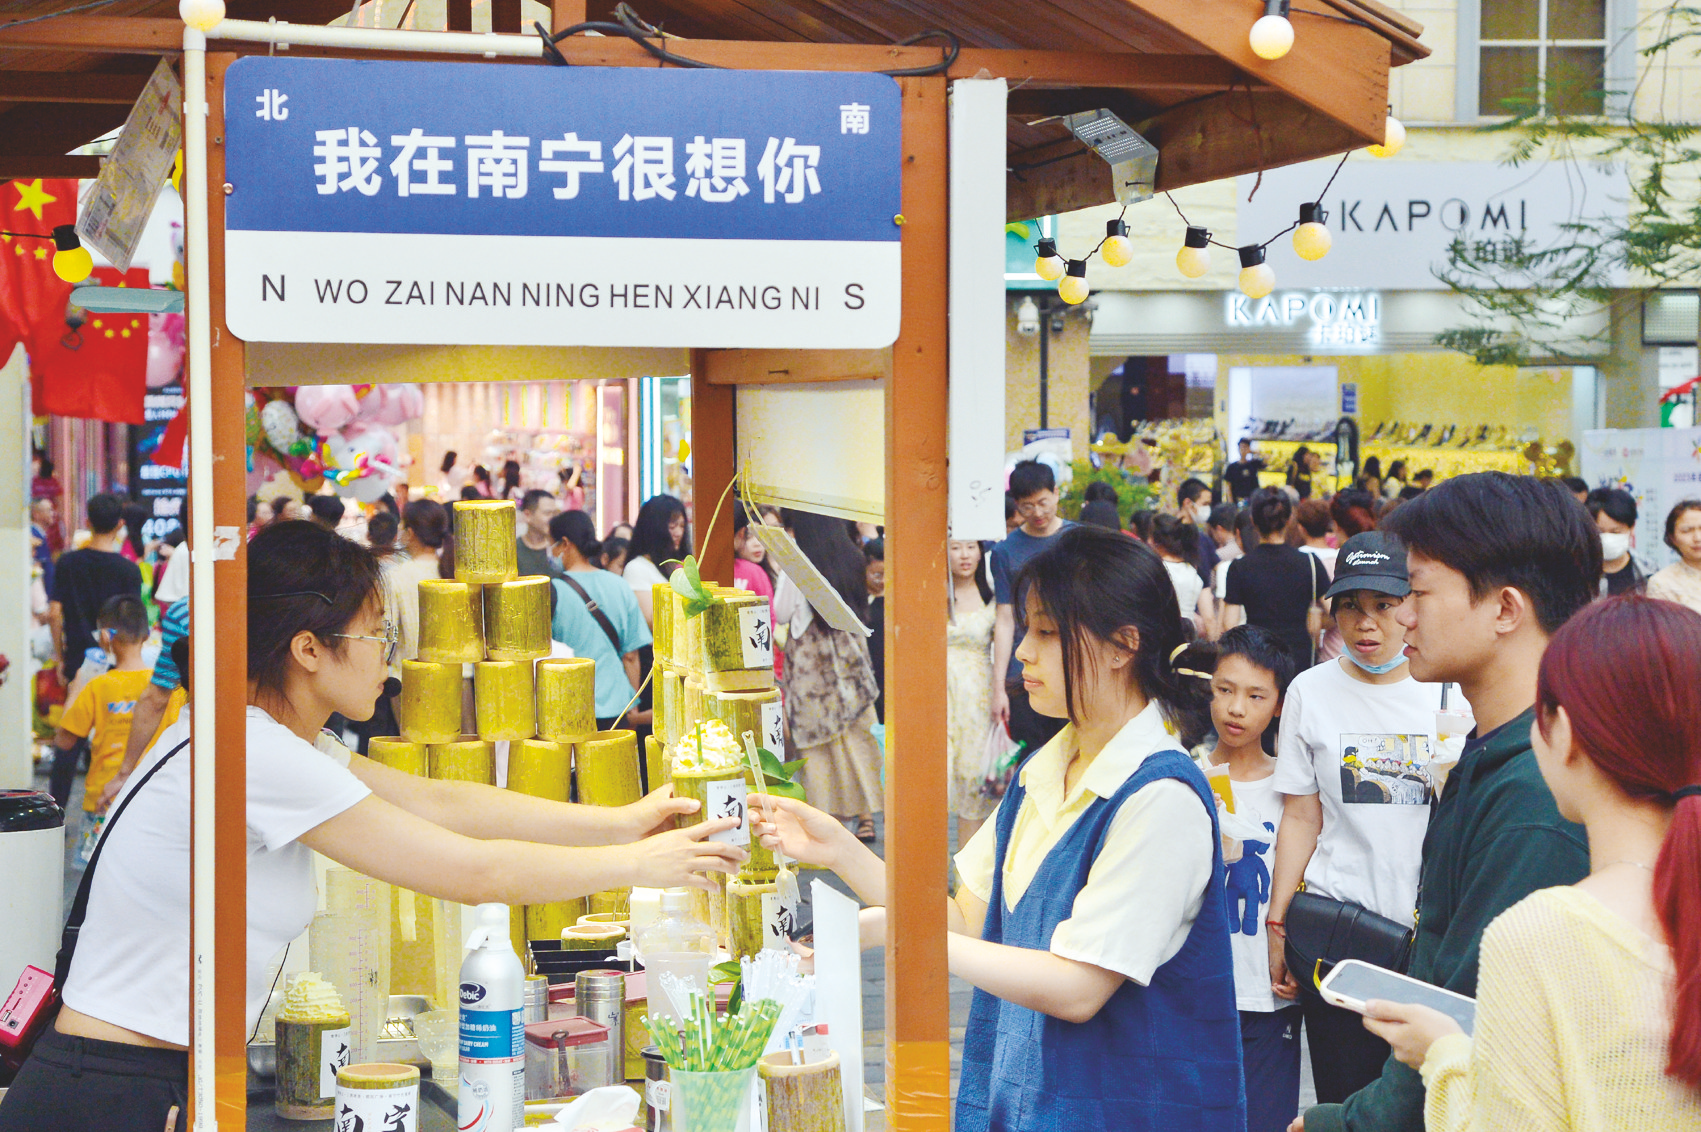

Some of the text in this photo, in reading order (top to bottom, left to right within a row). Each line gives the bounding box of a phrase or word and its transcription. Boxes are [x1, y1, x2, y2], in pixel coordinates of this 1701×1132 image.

[256, 89, 290, 121] 北
[839, 102, 873, 136] 南
[313, 127, 824, 206] 我在南宁很想你
[1341, 197, 1526, 232] KAPOMI
[262, 274, 865, 310] N WO ZAI NAN NING HEN XIANG NI S
[1227, 293, 1379, 326] KAPOMI
[749, 618, 771, 652] 南
[770, 905, 794, 939] 南
[459, 988, 480, 1001] Debic
